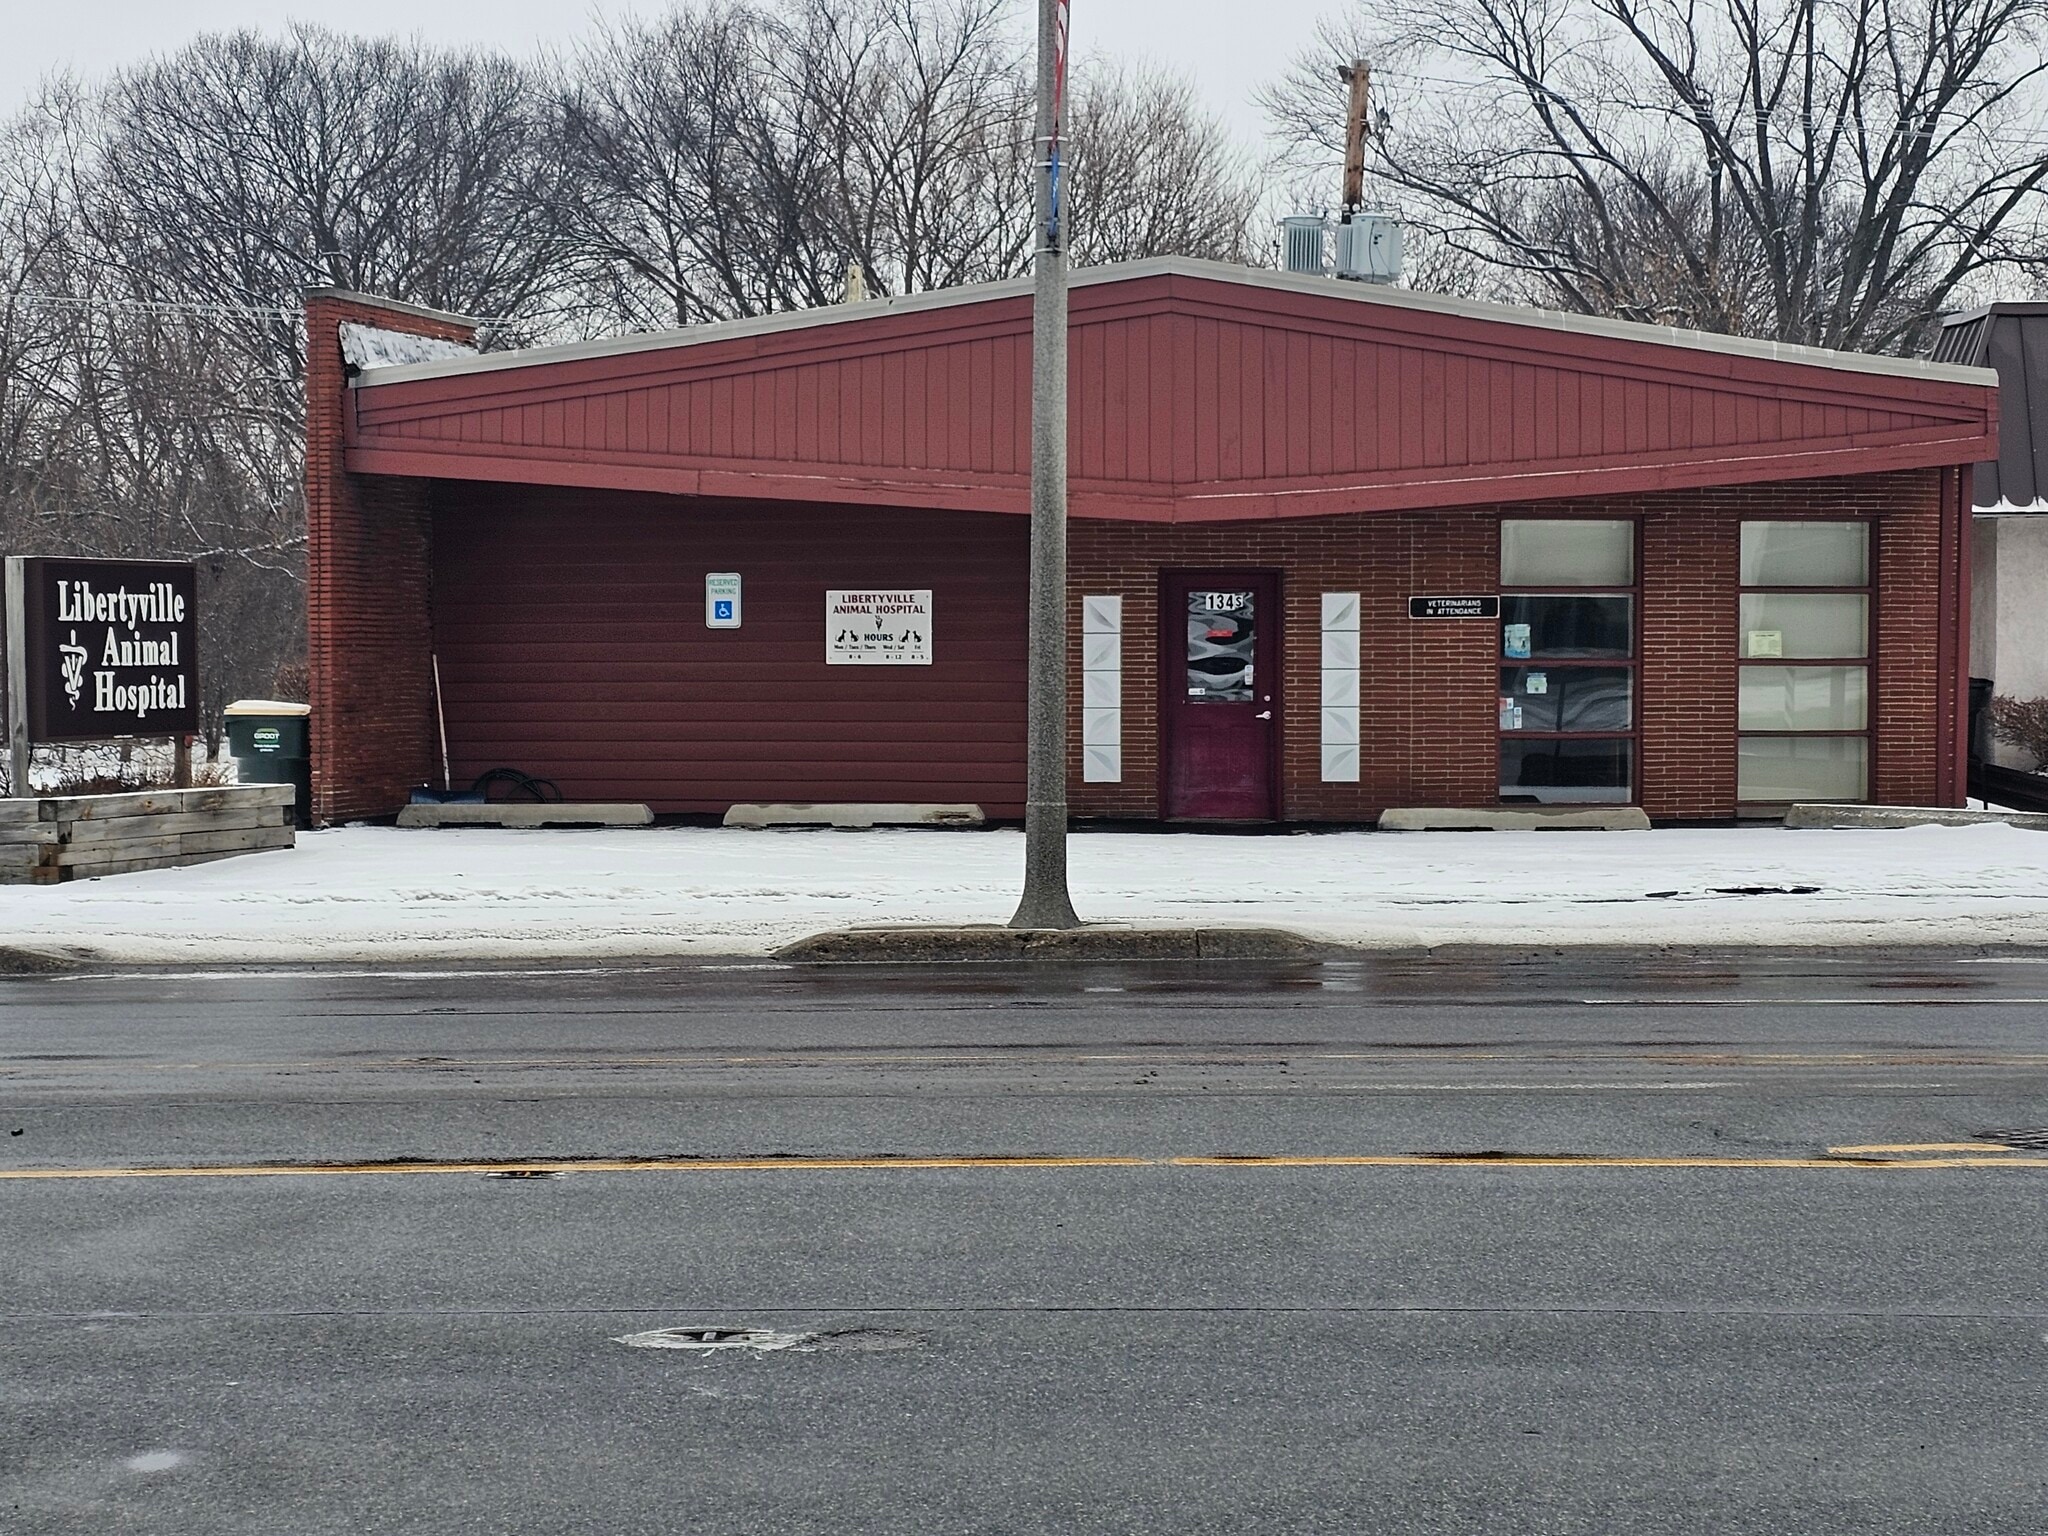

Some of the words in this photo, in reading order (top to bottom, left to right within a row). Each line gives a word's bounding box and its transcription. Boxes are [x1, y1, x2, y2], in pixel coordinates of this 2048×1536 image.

[709, 578, 738, 586] RESERVED
[711, 587, 736, 595] PARKING
[842, 594, 916, 604] LIBERTYVILLE
[57, 580, 185, 630] Libertyville
[833, 605, 872, 614] ANIMAL
[876, 605, 926, 614] HOSPITAL
[1437, 607, 1482, 615] ATTENDANCE
[864, 633, 894, 642] HOURS
[101, 626, 179, 666] Animal
[93, 671, 186, 718] Hospital
